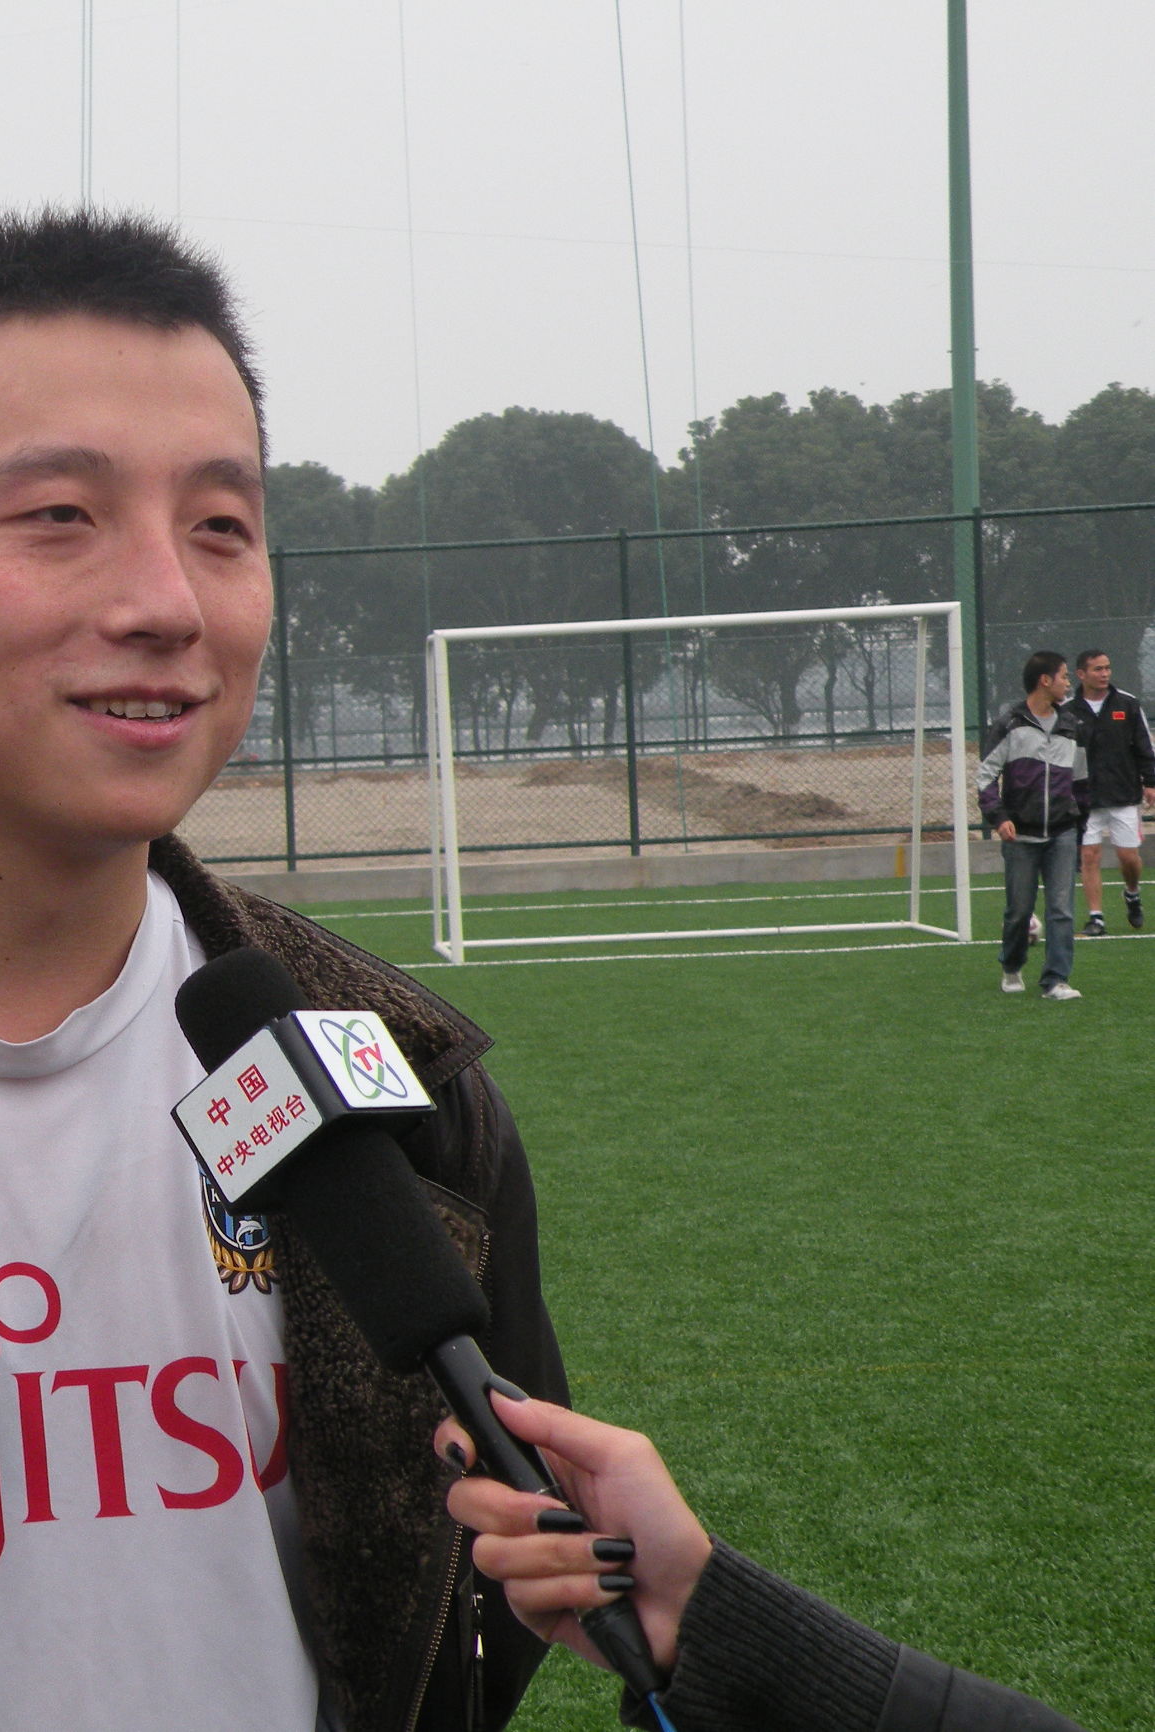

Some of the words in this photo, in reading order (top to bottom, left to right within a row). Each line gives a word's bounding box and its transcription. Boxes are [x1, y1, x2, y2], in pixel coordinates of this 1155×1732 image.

[206, 1063, 269, 1127] 中国
[216, 1093, 306, 1176] 中央电视台
